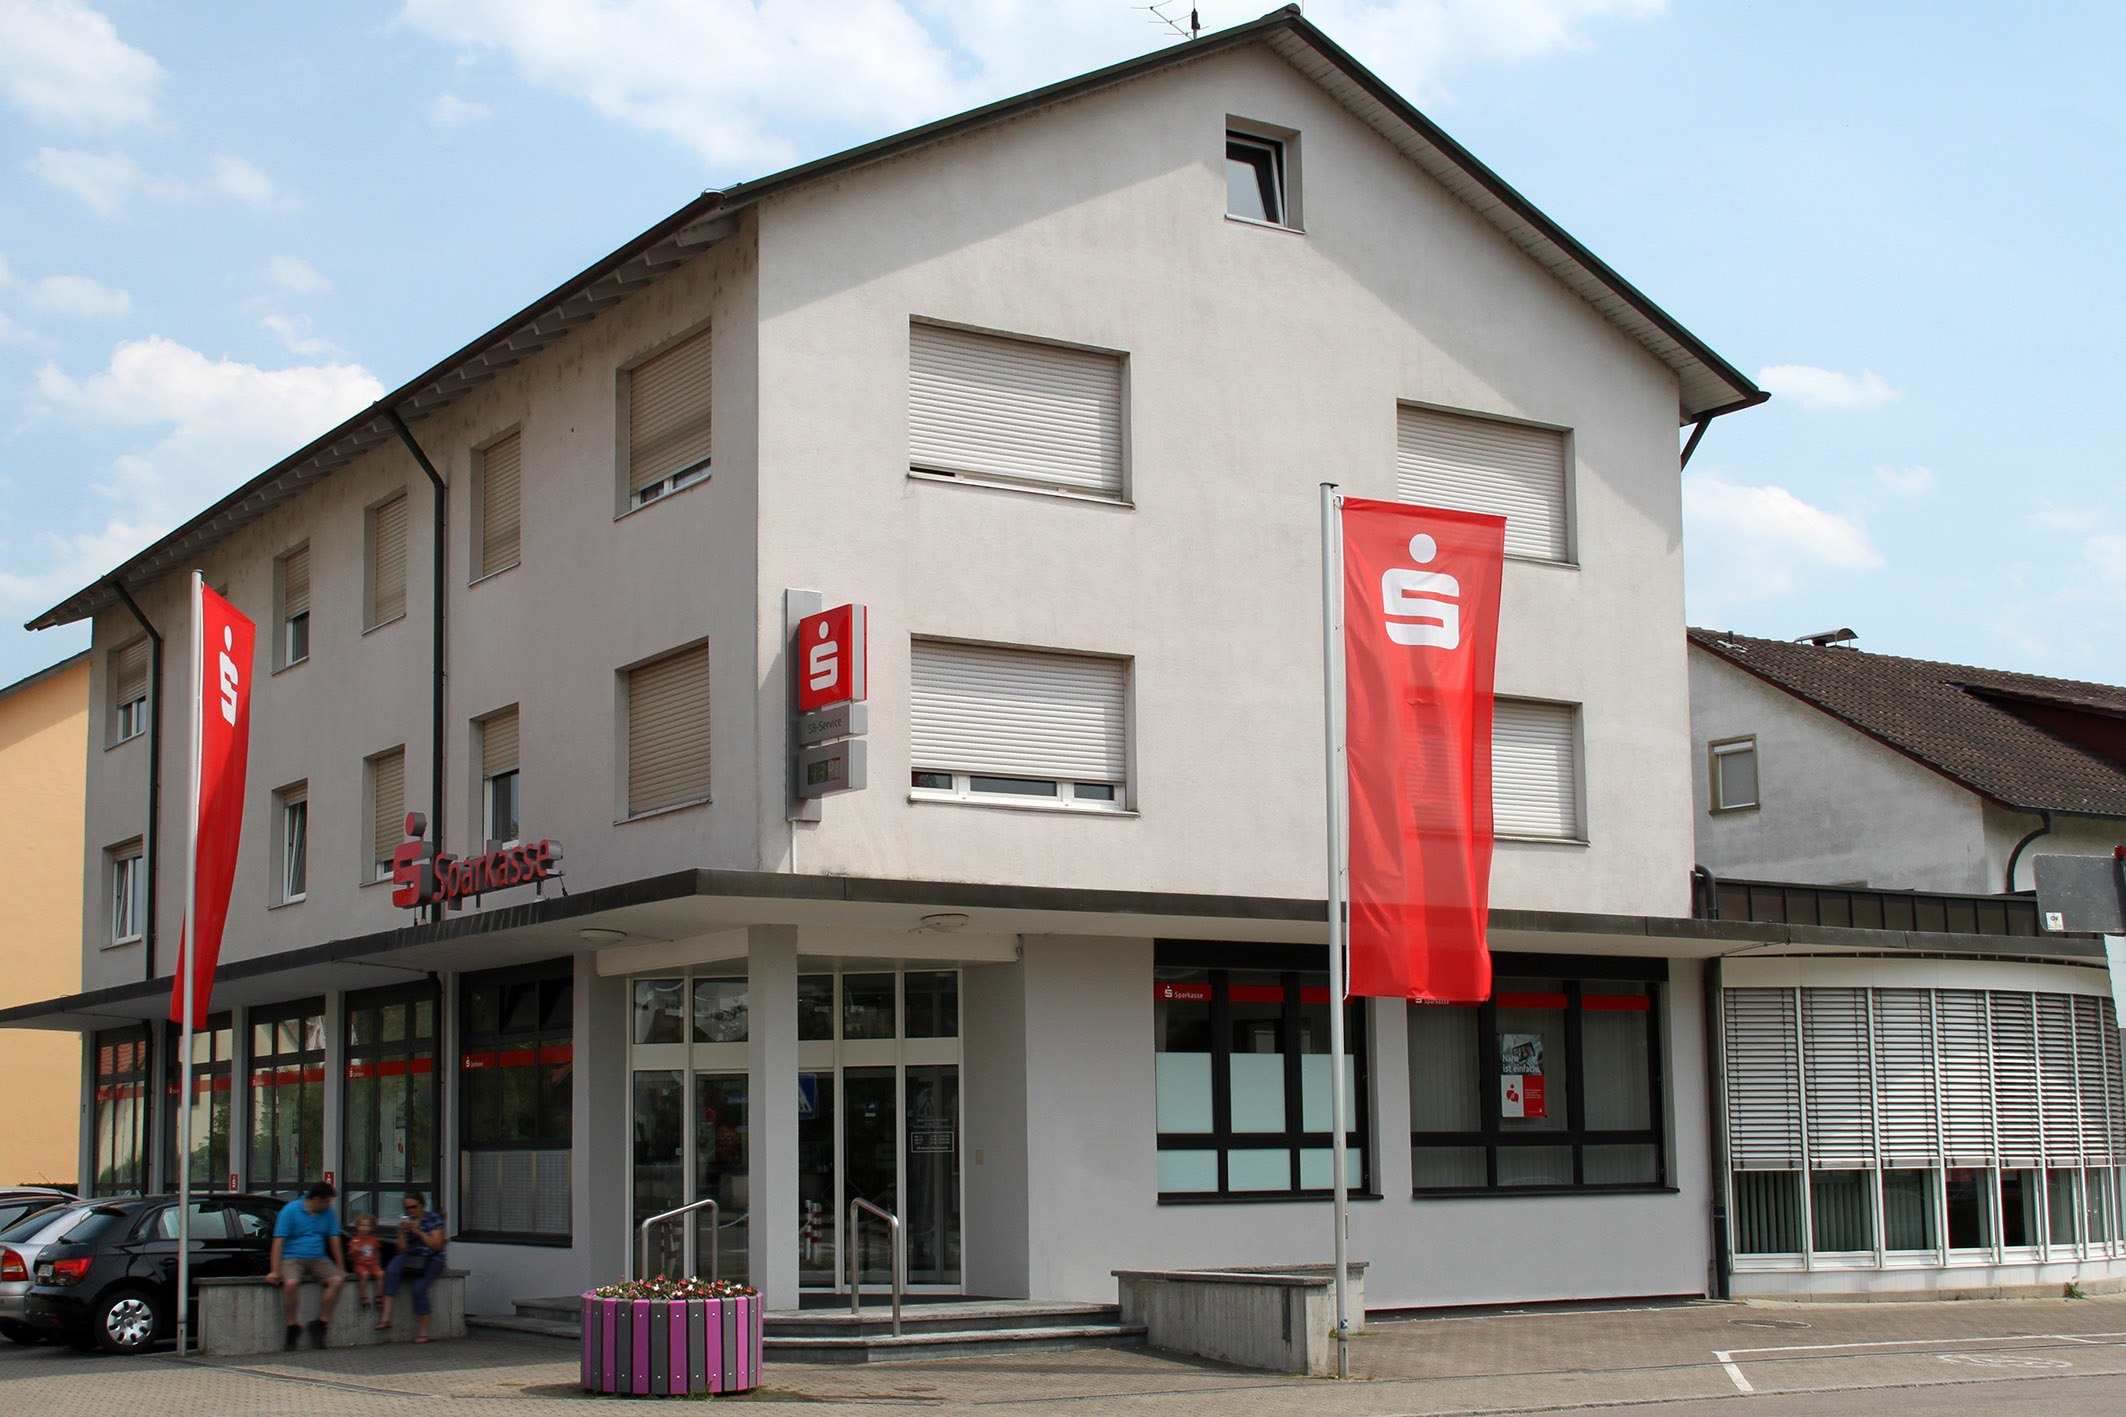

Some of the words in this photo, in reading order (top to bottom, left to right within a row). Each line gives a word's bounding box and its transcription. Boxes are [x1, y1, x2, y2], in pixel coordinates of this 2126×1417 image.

[807, 716, 842, 735] SB-Service
[432, 839, 551, 906] Sparkasse
[1174, 991, 1203, 999] Sparkasse
